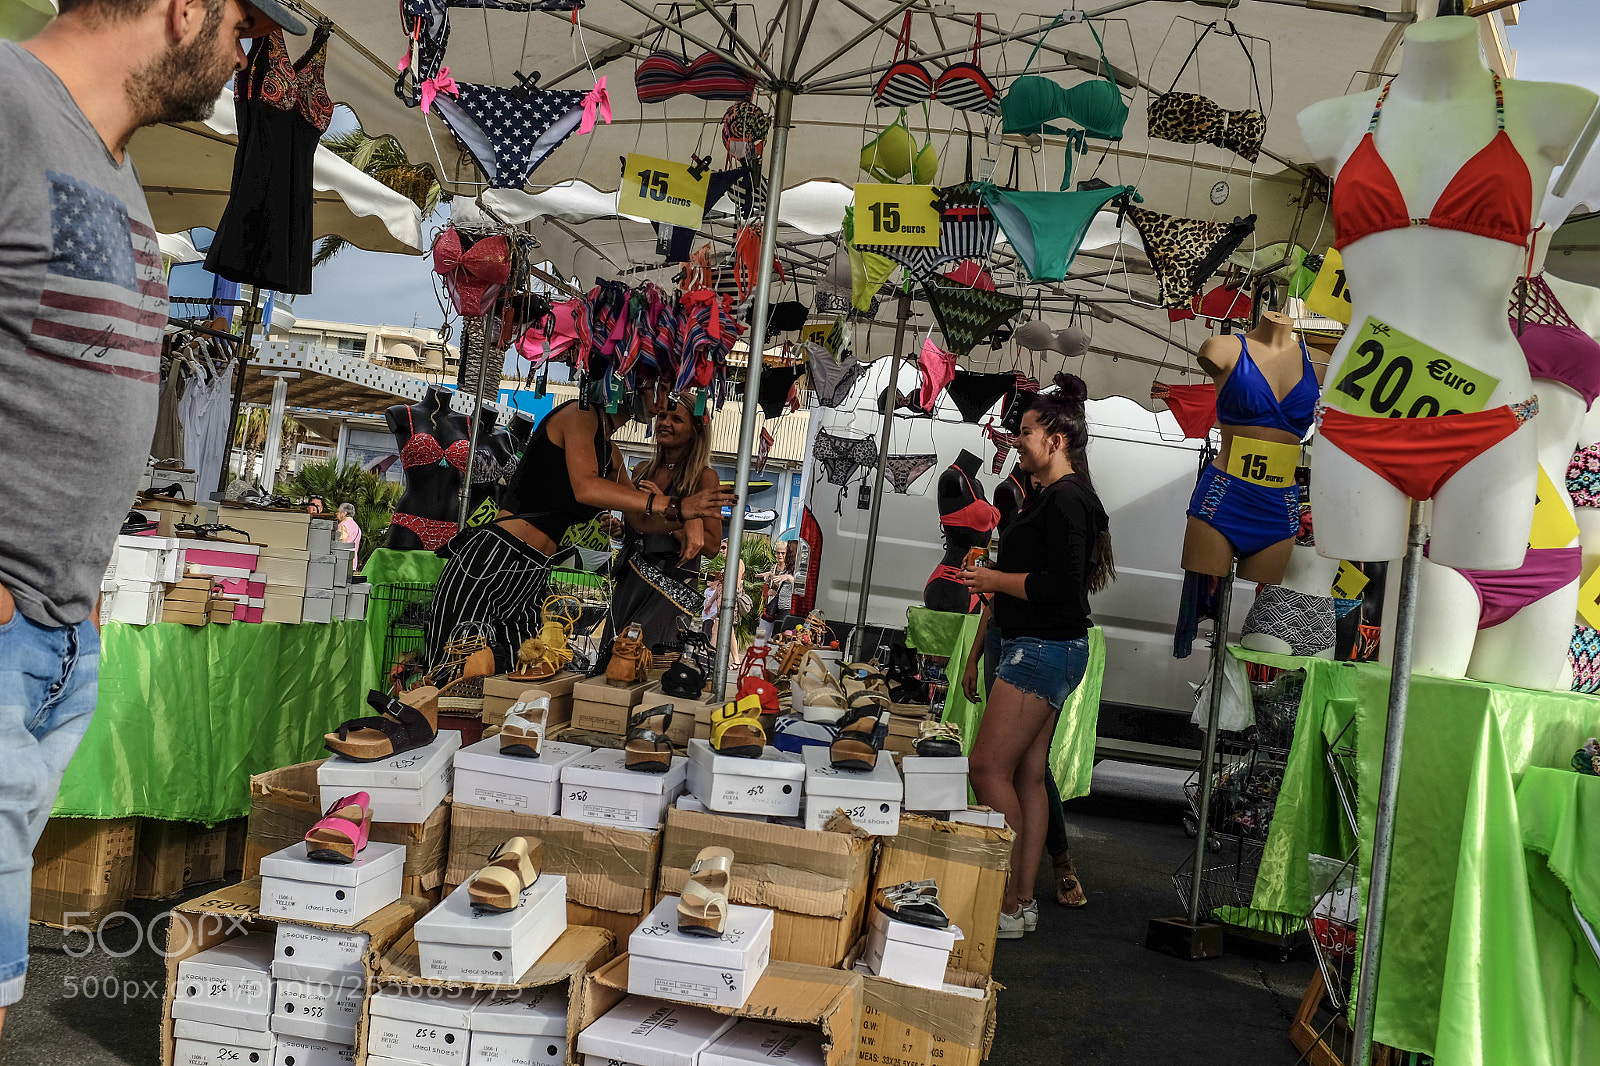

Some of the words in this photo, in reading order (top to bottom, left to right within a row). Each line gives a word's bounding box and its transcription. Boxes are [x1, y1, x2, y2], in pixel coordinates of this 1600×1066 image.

[638, 169, 669, 201] 15
[666, 195, 692, 207] euros
[868, 202, 900, 233] 15
[901, 225, 926, 234] euros
[1241, 453, 1268, 480] 15
[415, 1028, 437, 1039] 25€
[905, 1028, 911, 1036] 8
[412, 1043, 431, 1052] ideal
[902, 1043, 912, 1053] 5.7
[217, 1048, 239, 1060] 25€
[859, 1051, 880, 1063] MEAS:
